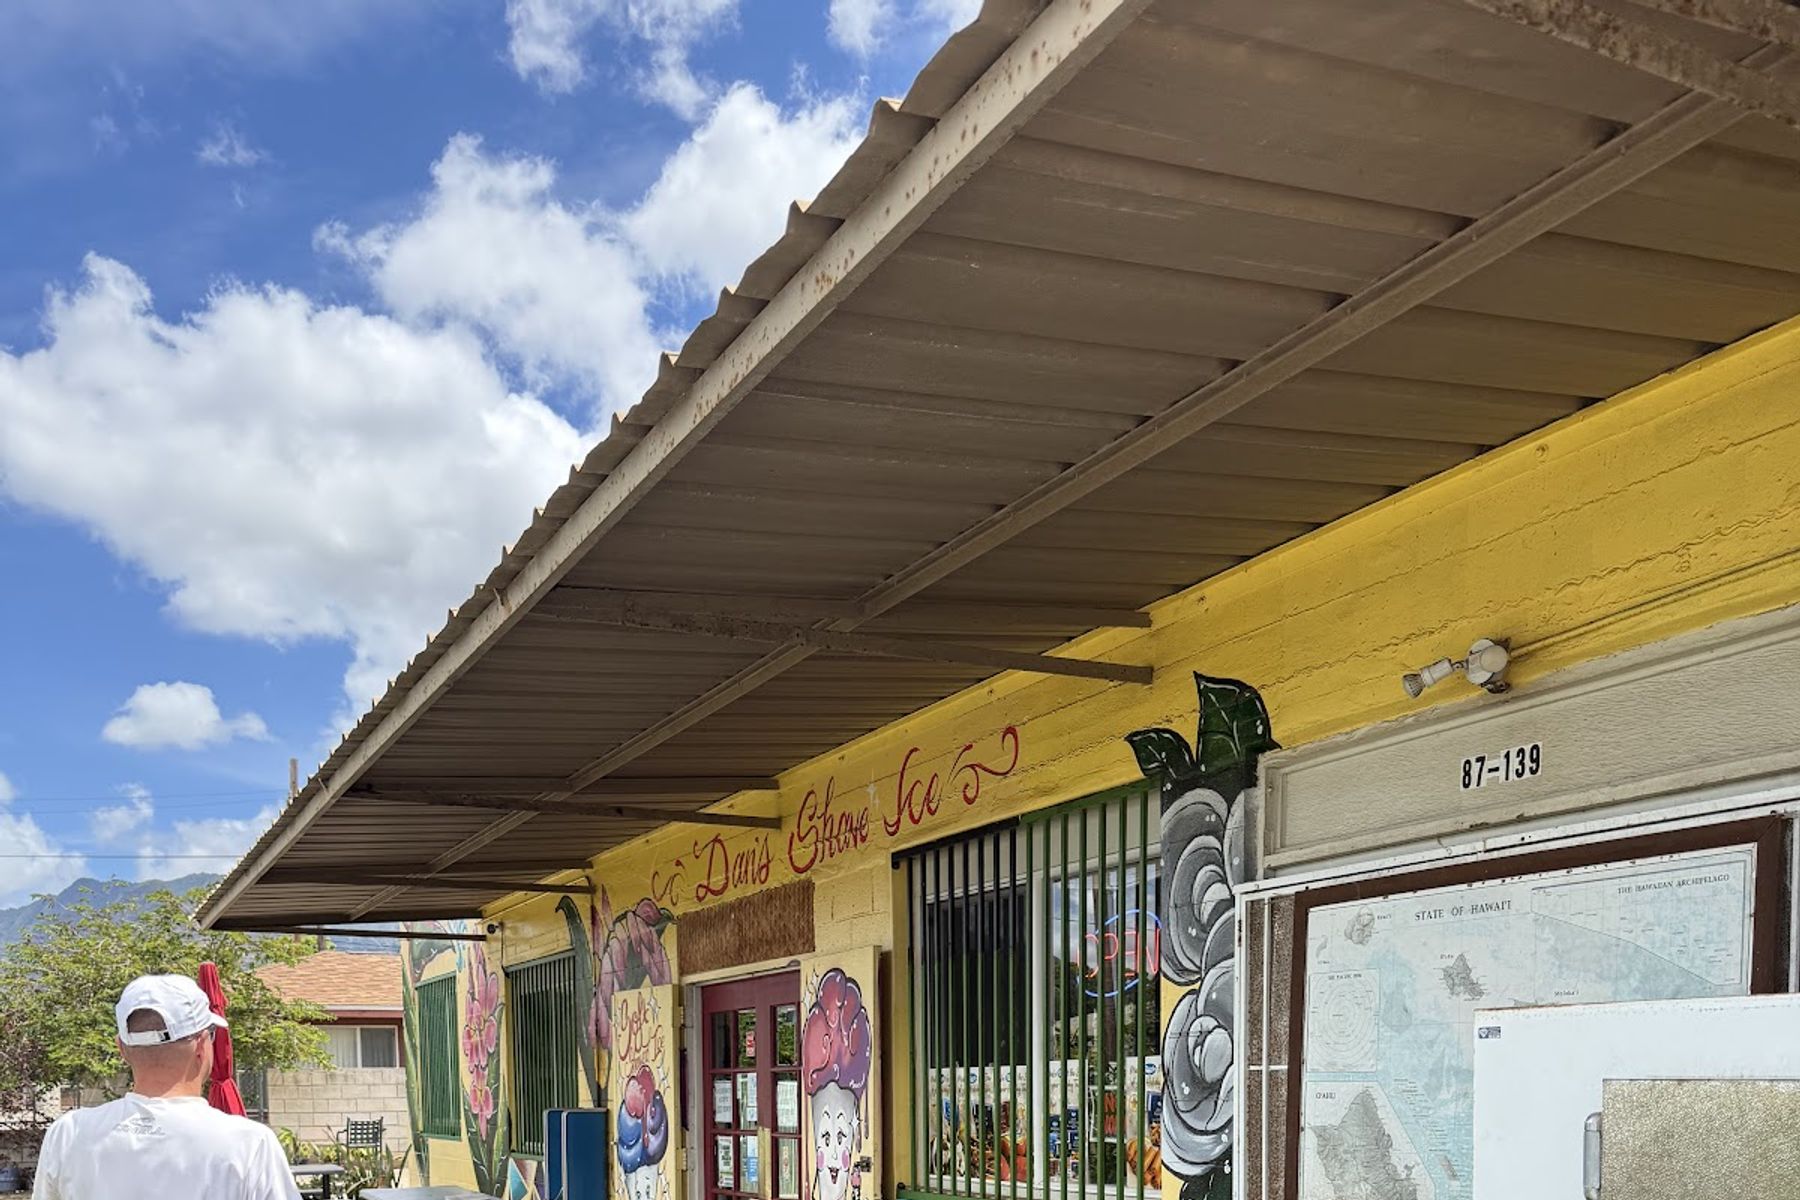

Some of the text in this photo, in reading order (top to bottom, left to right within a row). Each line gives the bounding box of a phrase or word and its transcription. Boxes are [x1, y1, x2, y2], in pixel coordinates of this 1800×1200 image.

[1462, 744, 1541, 789] 87-139
[788, 776, 870, 873] Shave
[883, 747, 940, 836] Ice
[1618, 886, 1632, 894] THE
[1676, 874, 1730, 887] ARCHIPELAGO
[1414, 908, 1444, 921] STATE
[1450, 906, 1464, 917] OF
[1076, 928, 1161, 978] OPEN
